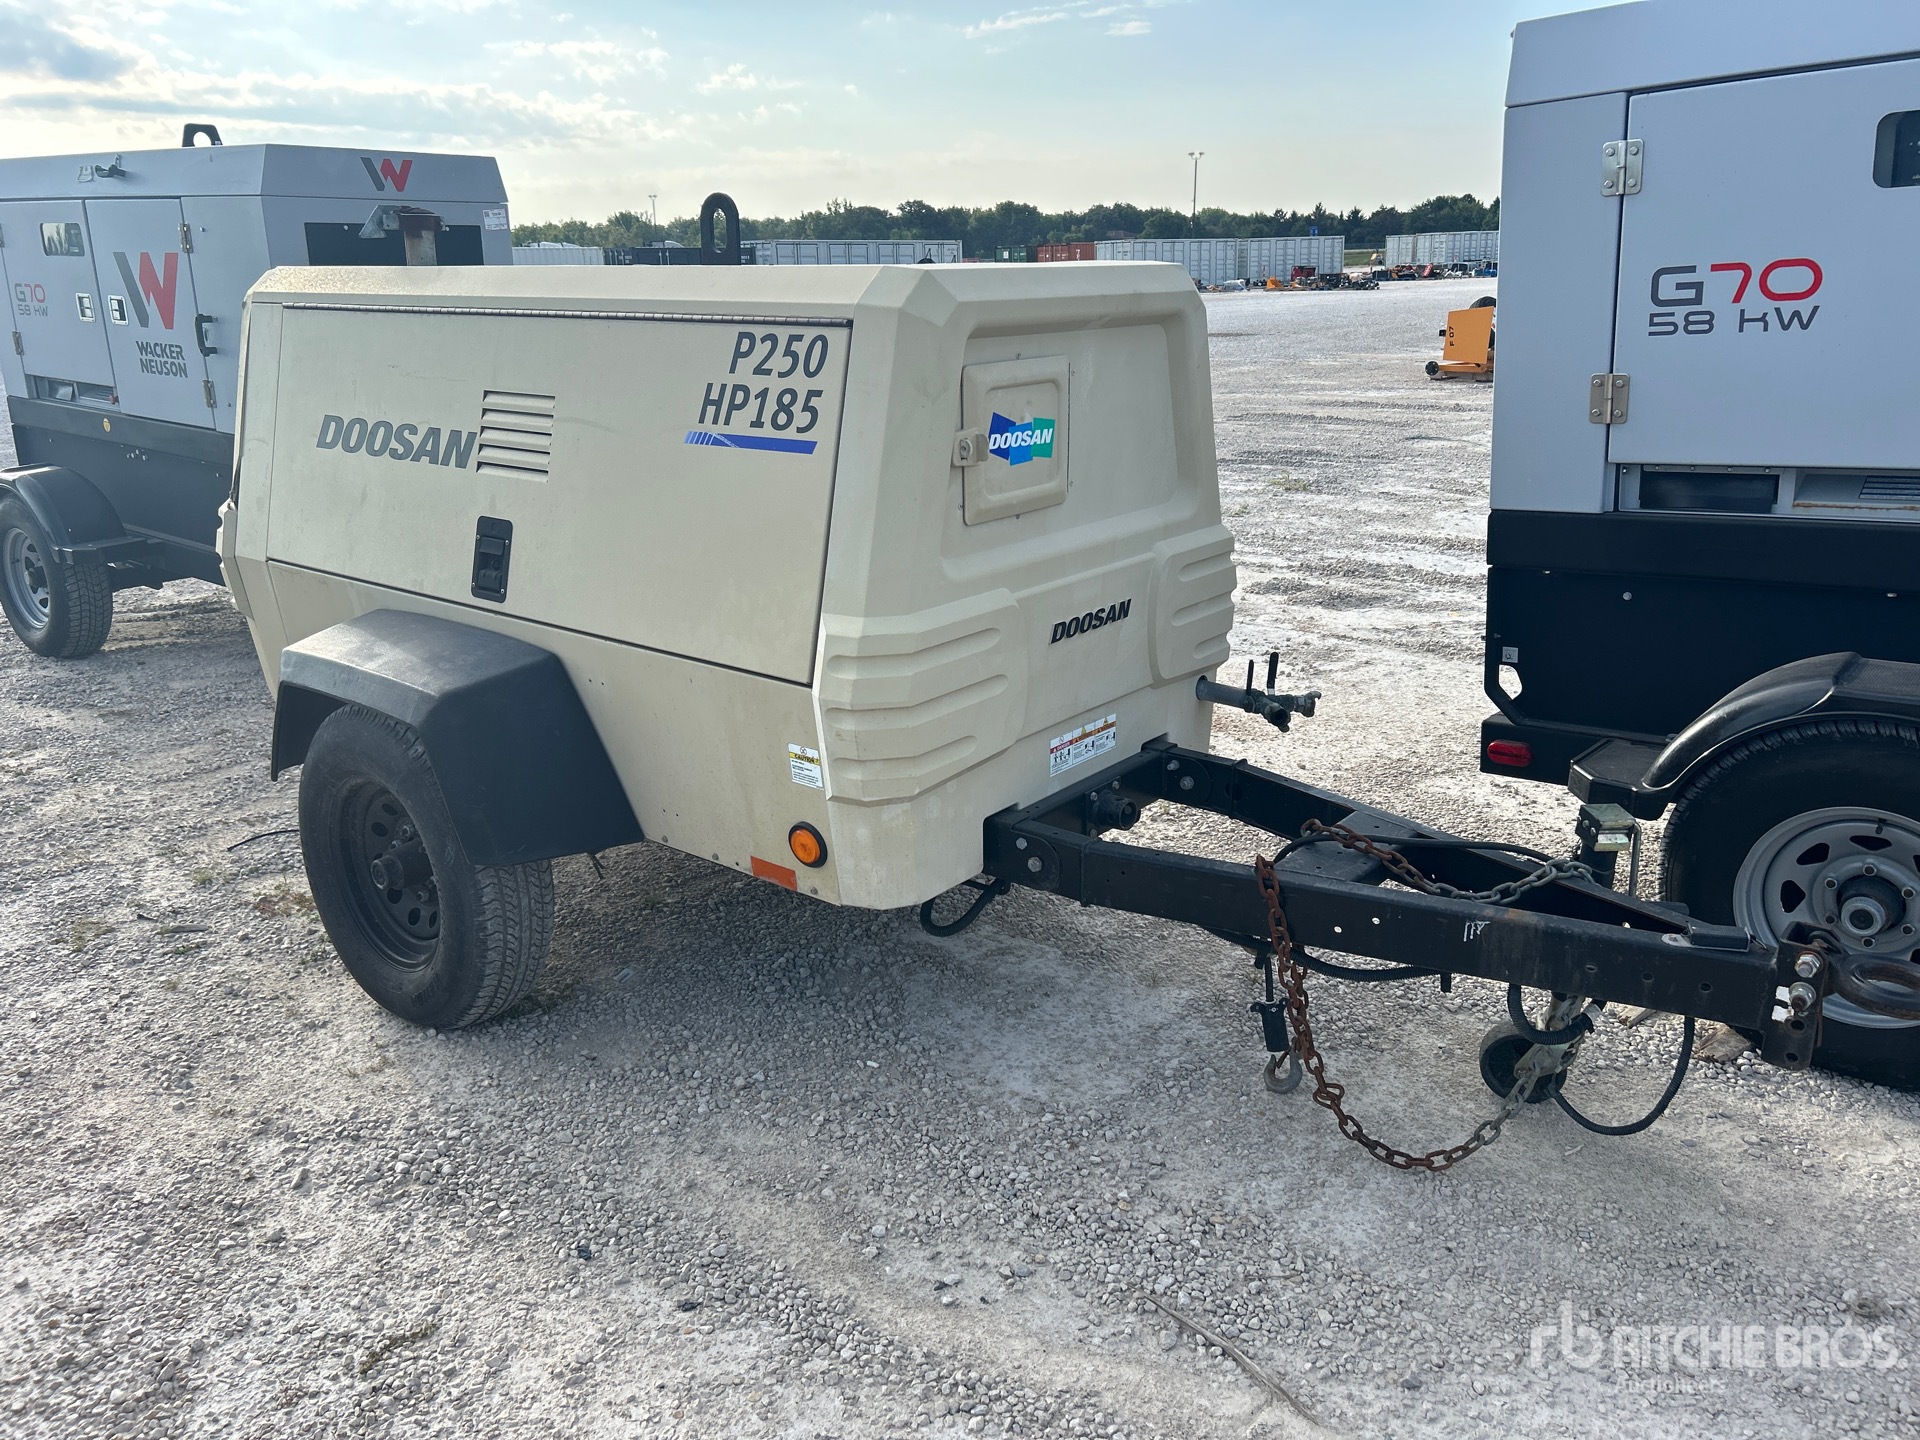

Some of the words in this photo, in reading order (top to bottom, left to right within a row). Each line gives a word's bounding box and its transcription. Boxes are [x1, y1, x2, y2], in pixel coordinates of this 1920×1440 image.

[14, 282, 46, 304] G70
[1650, 257, 1824, 308] G70
[17, 303, 32, 316] 58
[1648, 310, 1716, 337] 58
[135, 340, 186, 361] WACKER
[728, 331, 829, 379] P250
[139, 357, 189, 379] NEUSON
[698, 382, 824, 434] HP185
[316, 414, 478, 470] DOOSAN
[988, 427, 1053, 450] DOOSAN
[1049, 598, 1132, 645] DOOSAN
